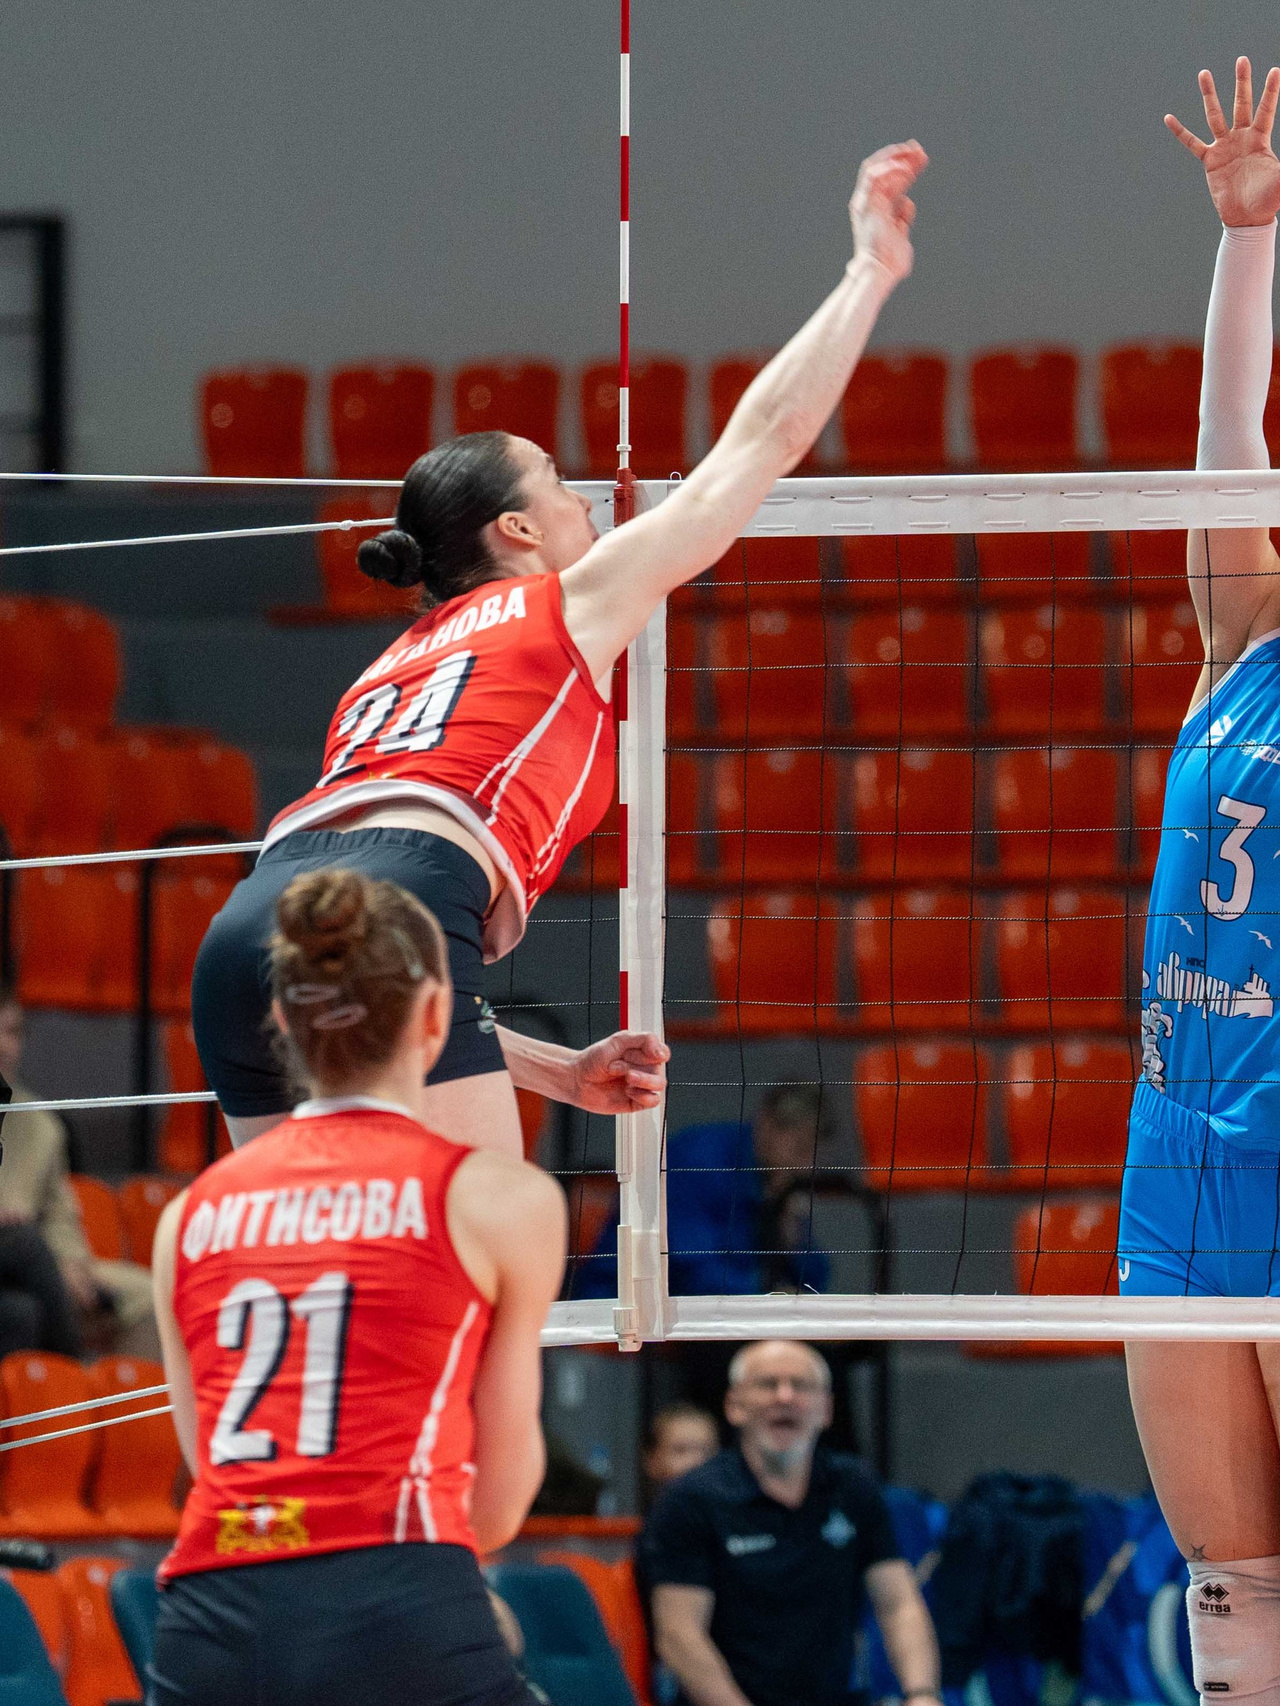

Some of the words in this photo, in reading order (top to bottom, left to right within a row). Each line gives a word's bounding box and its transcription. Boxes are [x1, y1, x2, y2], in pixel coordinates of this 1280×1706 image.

[316, 650, 478, 789] 24
[1200, 794, 1267, 922] 3
[181, 1177, 428, 1262] ФИТИСОВА
[210, 1271, 354, 1466] 21
